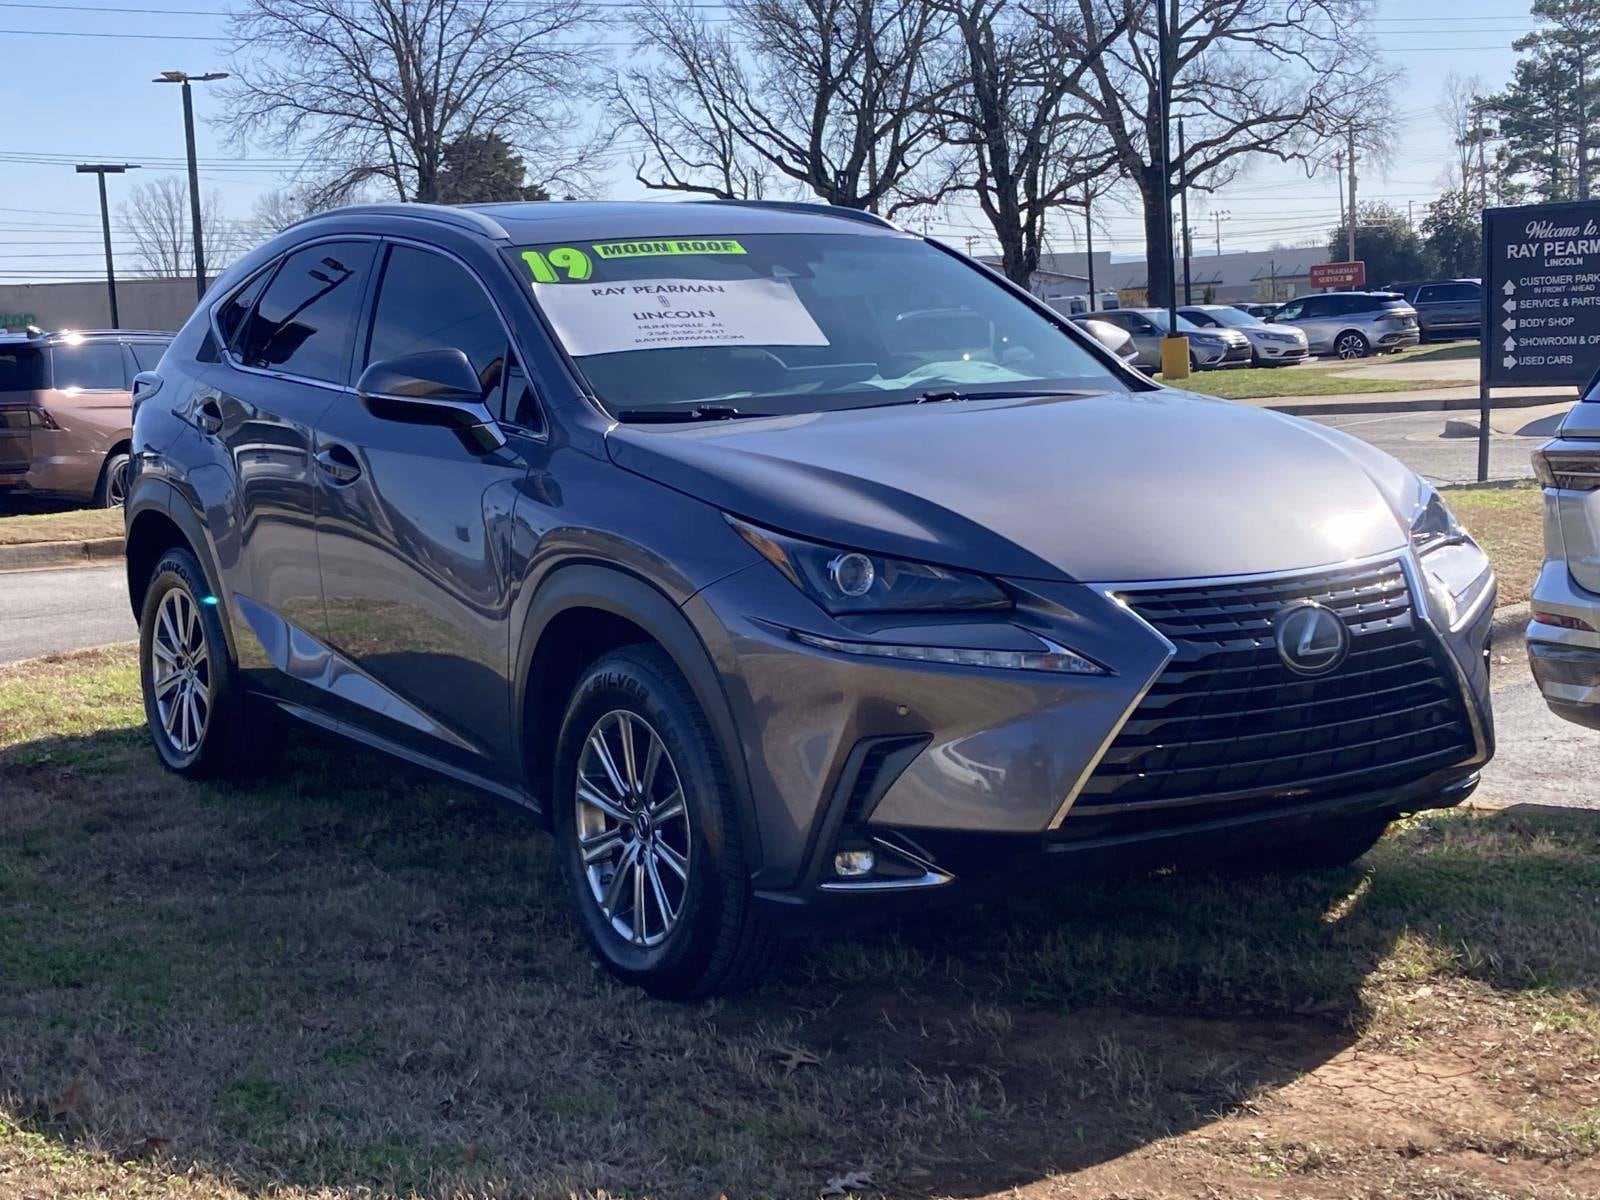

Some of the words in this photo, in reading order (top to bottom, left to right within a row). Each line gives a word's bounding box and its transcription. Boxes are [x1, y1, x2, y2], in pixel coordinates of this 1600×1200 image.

[1525, 220, 1580, 239] Welcome
[601, 242, 670, 256] MOON
[677, 239, 734, 252] ROOF
[1507, 243, 1540, 259] RAY
[521, 247, 593, 283] 19
[1544, 257, 1584, 267] LINCOLN
[1327, 267, 1358, 275] PEARMAN
[1318, 275, 1345, 283] SERVICE
[1520, 275, 1573, 286] CUSTOMER
[592, 286, 626, 297] RAY
[632, 284, 725, 294] PEARMAN
[1571, 284, 1596, 292] AHEAD
[1520, 299, 1560, 309] SERVICE
[1562, 298, 1569, 307] &
[633, 310, 716, 321] LINCOLN
[1519, 319, 1545, 328] BODY
[1548, 317, 1575, 327] SHOP
[634, 334, 745, 343] RAYPEARMAN.COM
[1519, 336, 1577, 347] SHOWROOM
[1579, 335, 1586, 345] &
[1519, 356, 1545, 366] USED
[1546, 355, 1574, 365] CARS
[592, 672, 650, 700] SILVER
